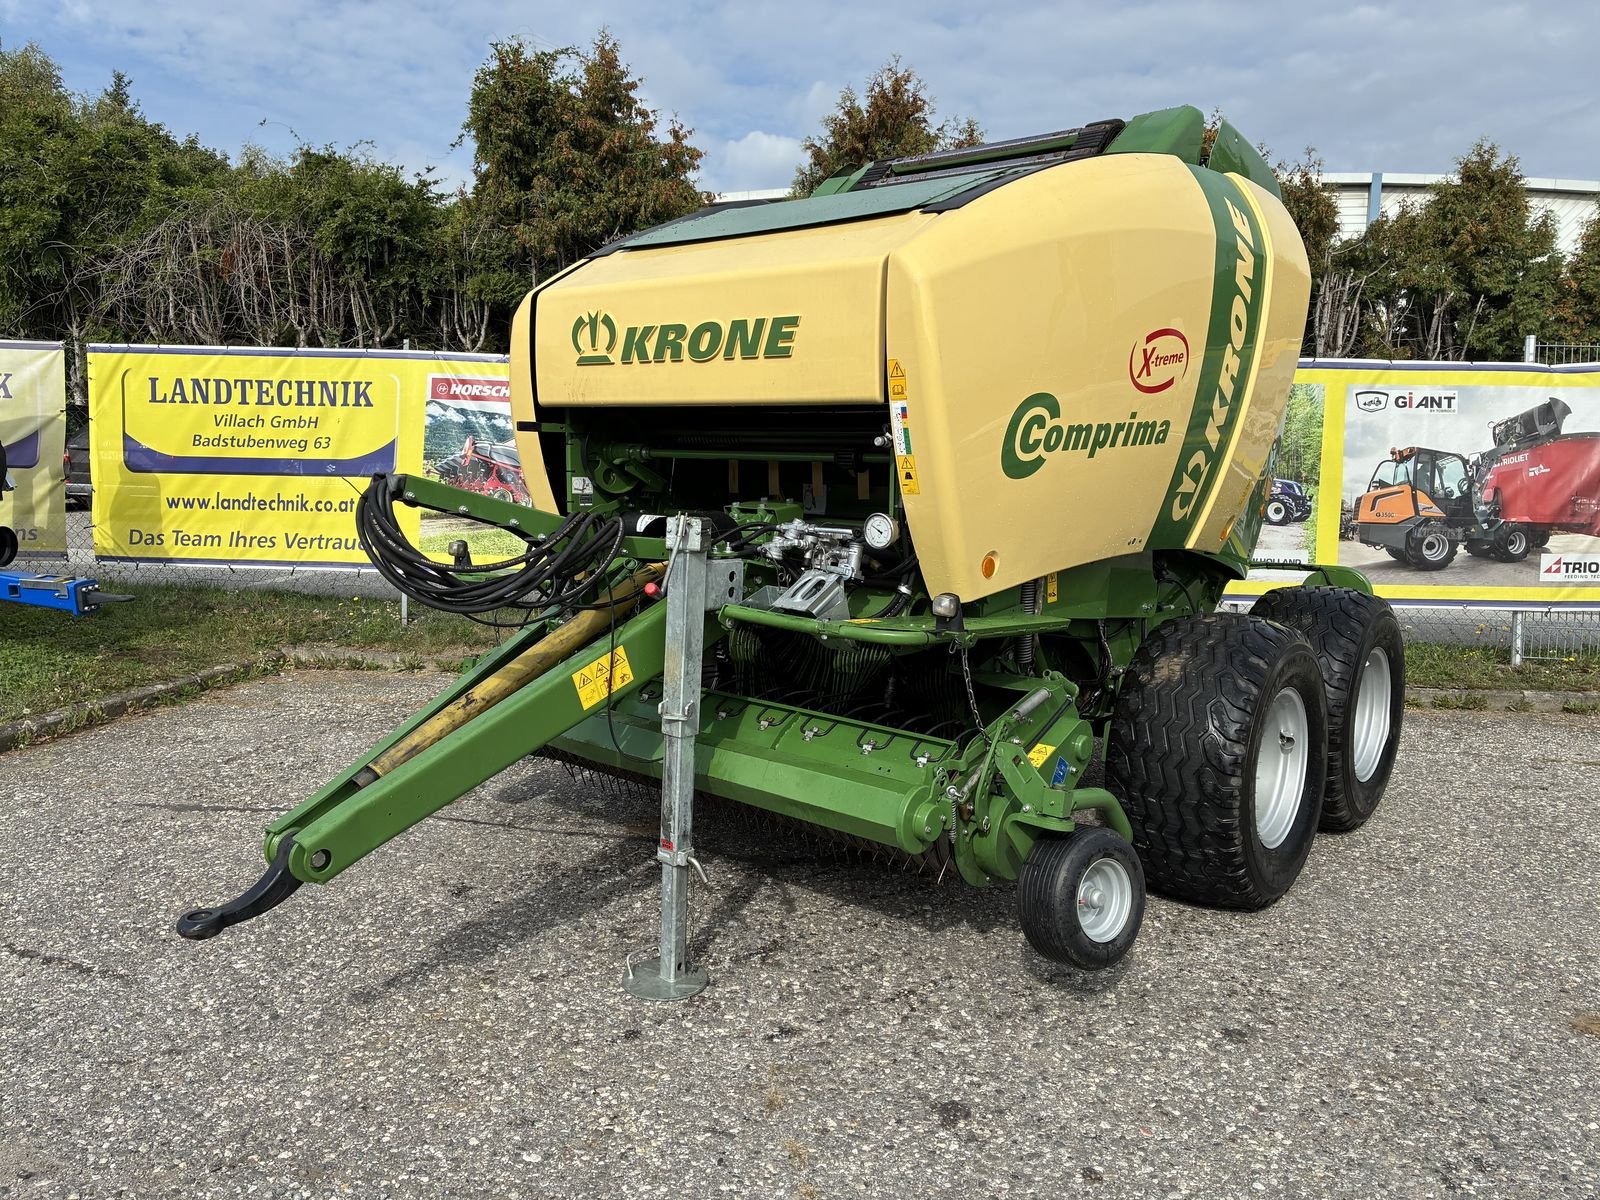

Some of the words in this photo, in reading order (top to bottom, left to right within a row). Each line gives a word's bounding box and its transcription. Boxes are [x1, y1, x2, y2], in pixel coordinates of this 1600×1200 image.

[1204, 196, 1254, 453] KRONE
[620, 316, 801, 364] KRONE
[1136, 346, 1184, 379] X-treme
[148, 377, 374, 407] LANDTECHNIK
[450, 383, 510, 397] HORSCH
[213, 413, 265, 429] Villach
[270, 415, 319, 429] GmbH
[192, 434, 308, 452] Badstubenweg
[313, 436, 331, 450] 63
[166, 491, 355, 512] www.landtechnik.co.at
[128, 529, 165, 546] Das
[172, 530, 222, 547] Team
[229, 531, 277, 549] Ihres
[1563, 562, 1600, 574] TRIO
